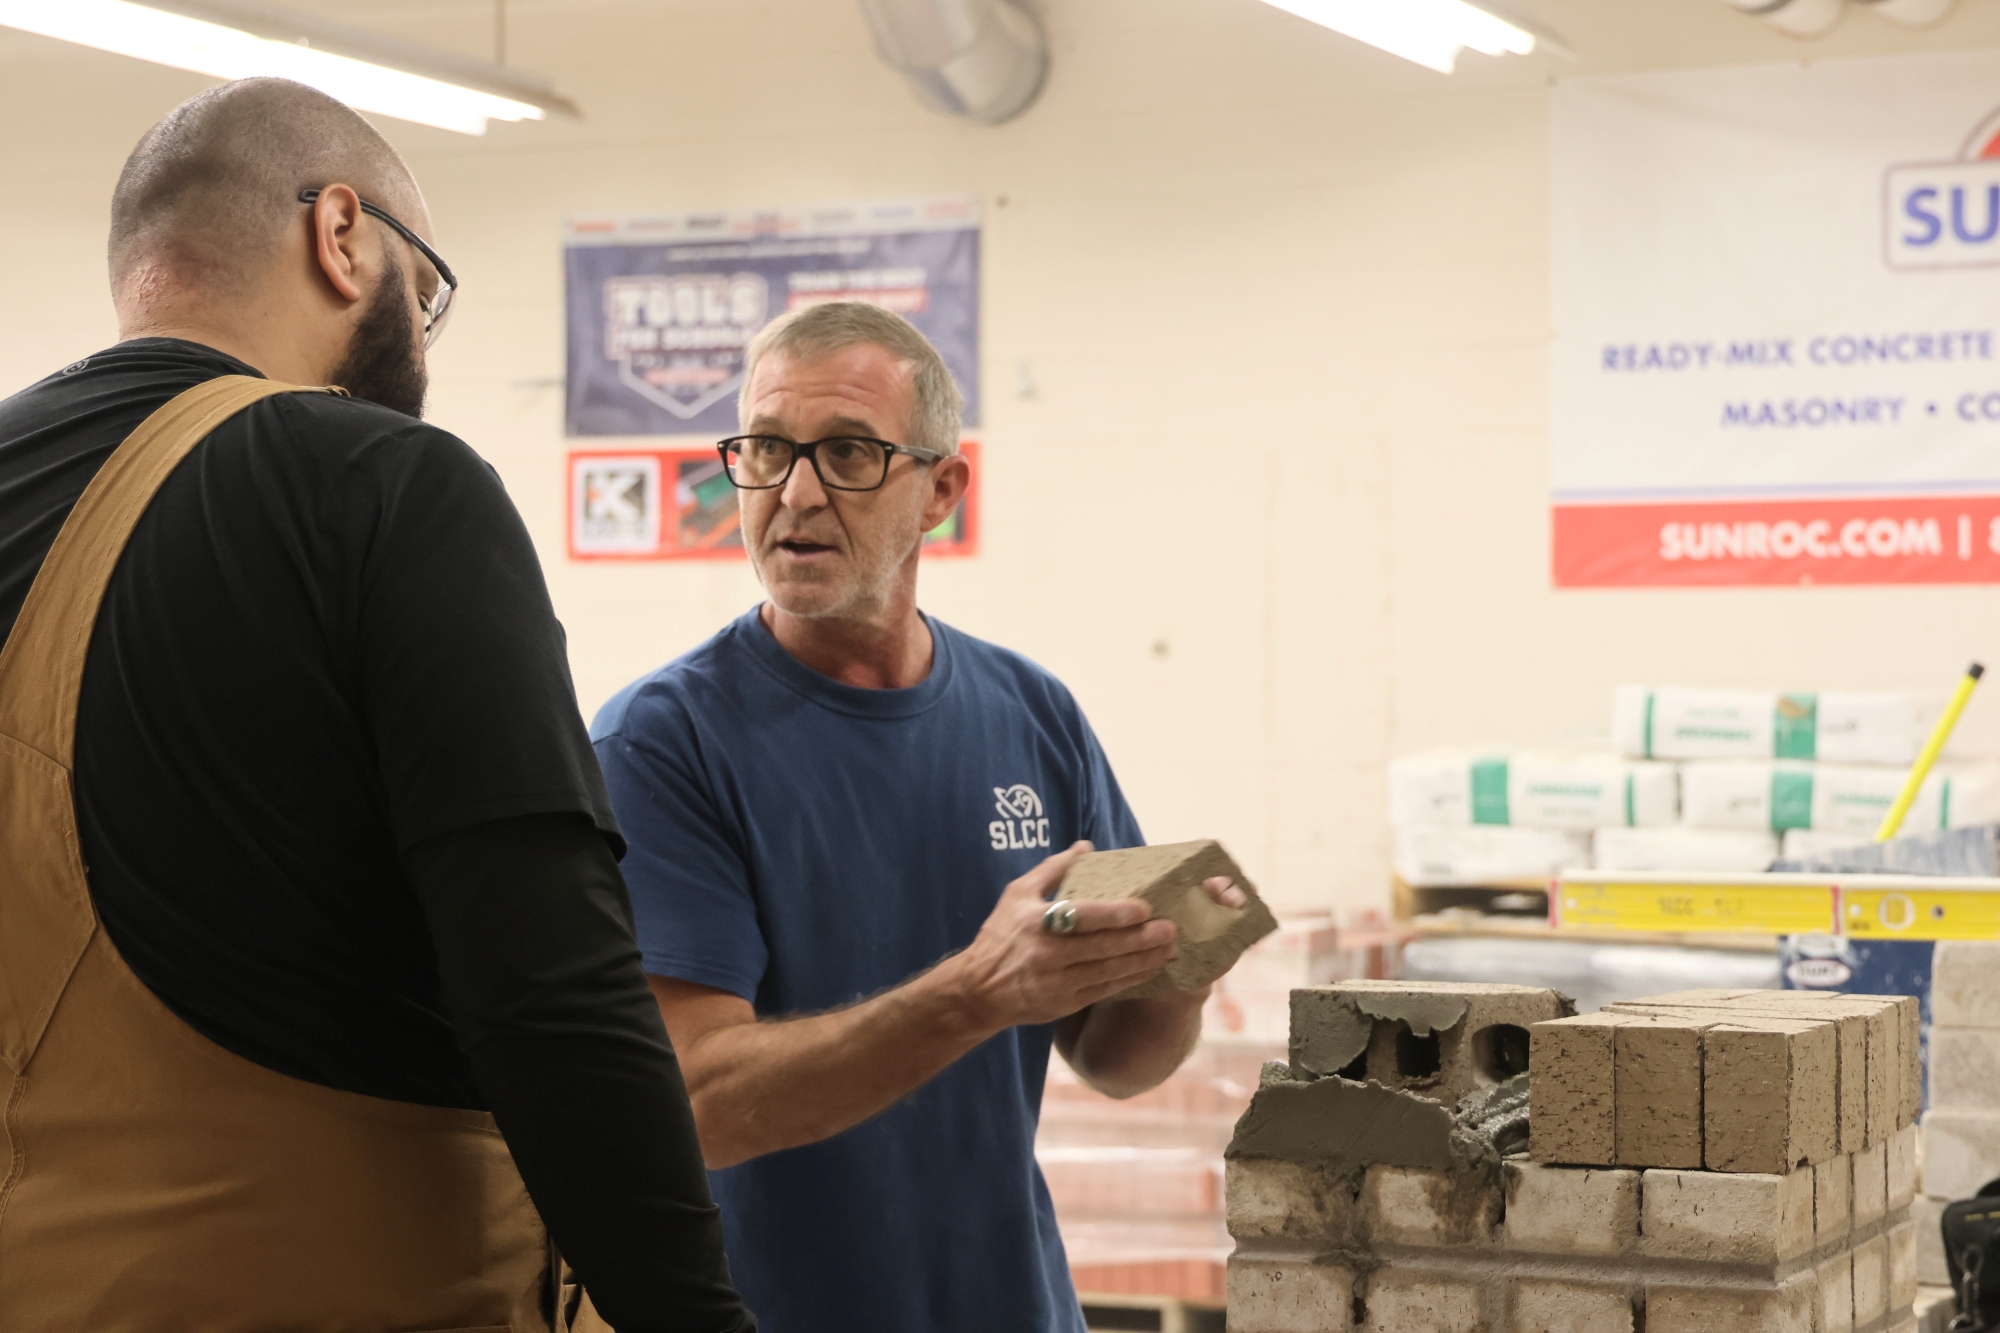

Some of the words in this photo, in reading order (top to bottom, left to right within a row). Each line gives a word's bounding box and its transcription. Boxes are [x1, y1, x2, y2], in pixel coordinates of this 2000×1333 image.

[1603, 341, 1795, 373] READY-MIX
[1808, 332, 1993, 367] CONCRETE
[1721, 396, 1905, 428] MASONRY
[1659, 518, 1942, 562] SUNROC.COM
[988, 818, 1050, 850] SLCC
